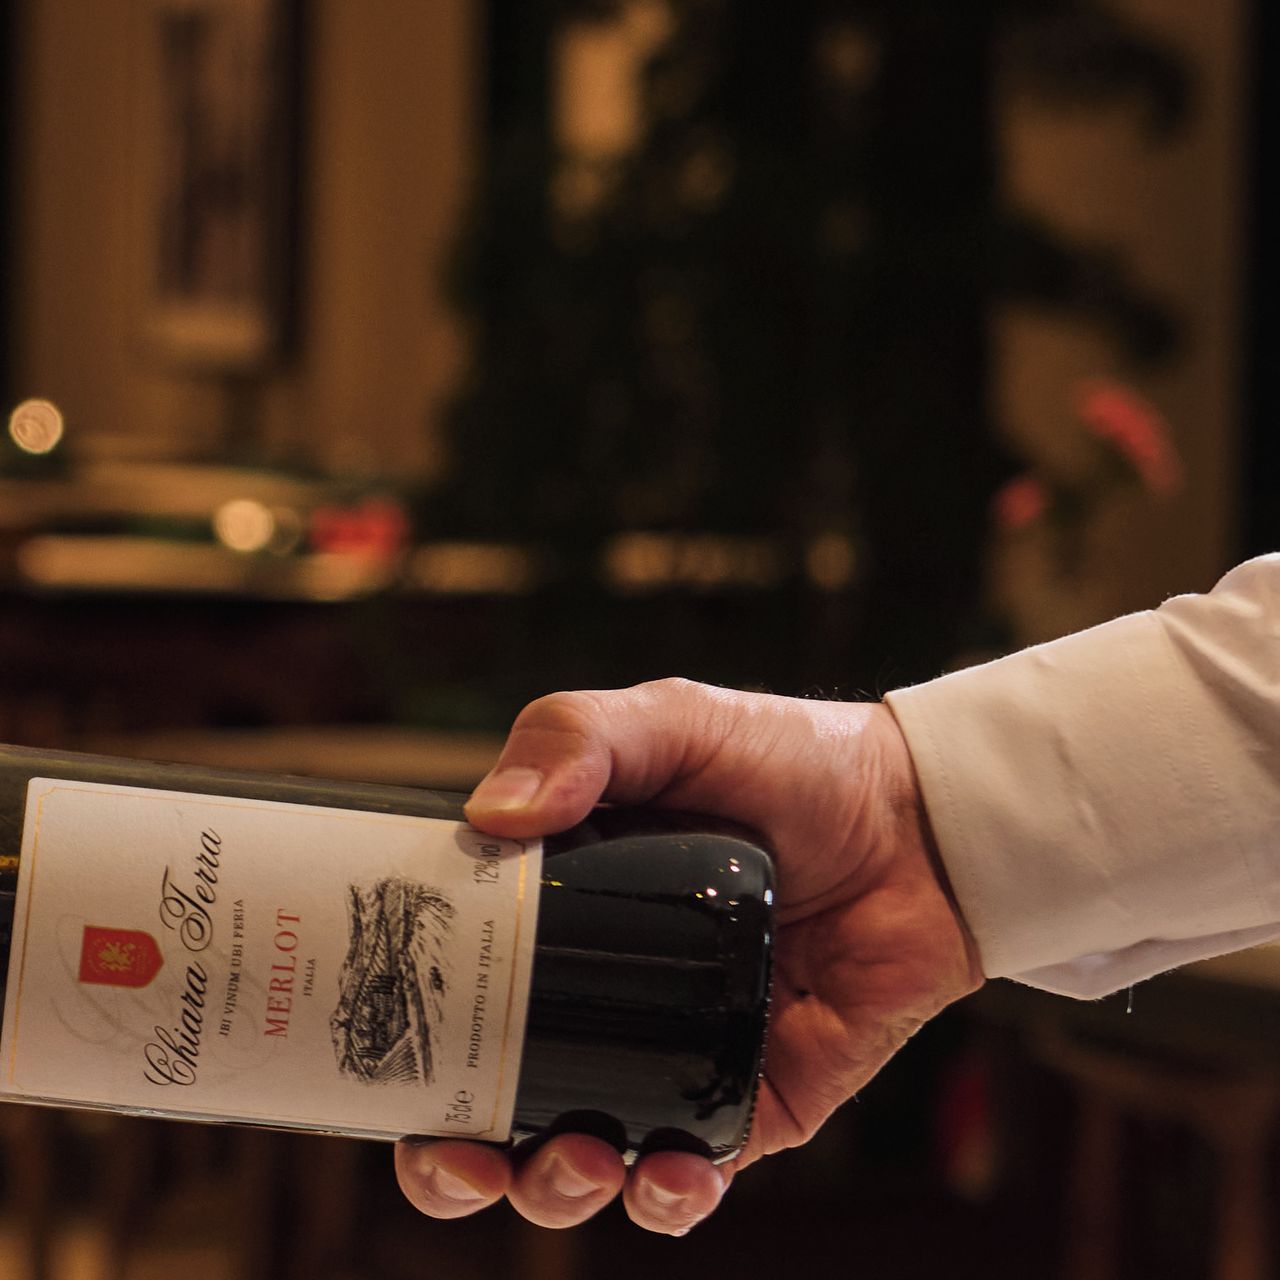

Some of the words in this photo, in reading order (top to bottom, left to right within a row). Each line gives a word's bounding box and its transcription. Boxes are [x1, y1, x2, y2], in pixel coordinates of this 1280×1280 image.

[159, 827, 222, 952] Terra
[232, 899, 244, 938] FERIA
[231, 944, 243, 968] UBI
[479, 920, 494, 968] ITALIA
[224, 972, 240, 1016] VINUM
[264, 908, 300, 1038] MERLOT
[304, 958, 316, 996] ITALIA
[476, 973, 489, 989] IN
[143, 961, 208, 1086] Chiara
[219, 1018, 233, 1037] IBI
[466, 994, 486, 1068] PRODOTTO
